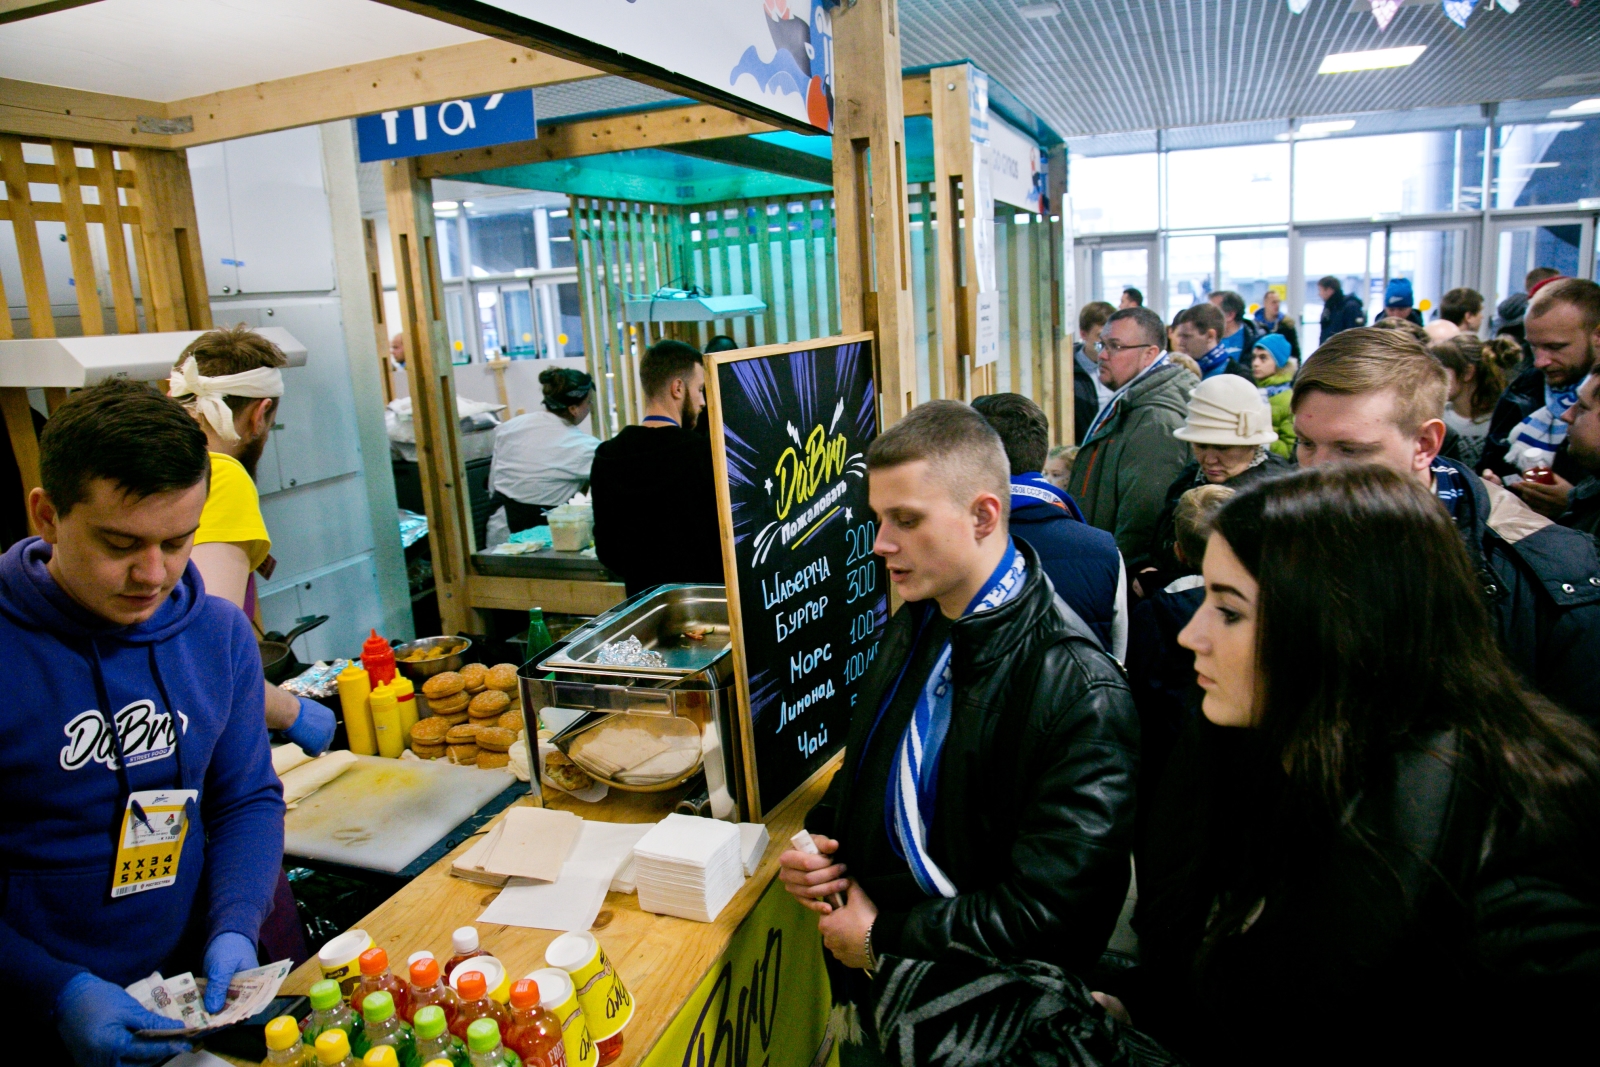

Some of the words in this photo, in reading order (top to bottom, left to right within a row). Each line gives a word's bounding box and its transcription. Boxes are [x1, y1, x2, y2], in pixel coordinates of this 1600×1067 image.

[781, 480, 847, 546] Пожаловать
[846, 520, 876, 566] 200
[846, 560, 876, 604] 300
[850, 610, 874, 644] 100
[775, 678, 836, 734] Лимонад
[129, 752, 151, 763] STREET
[151, 749, 168, 758] FOOD
[797, 722, 828, 759] Чай
